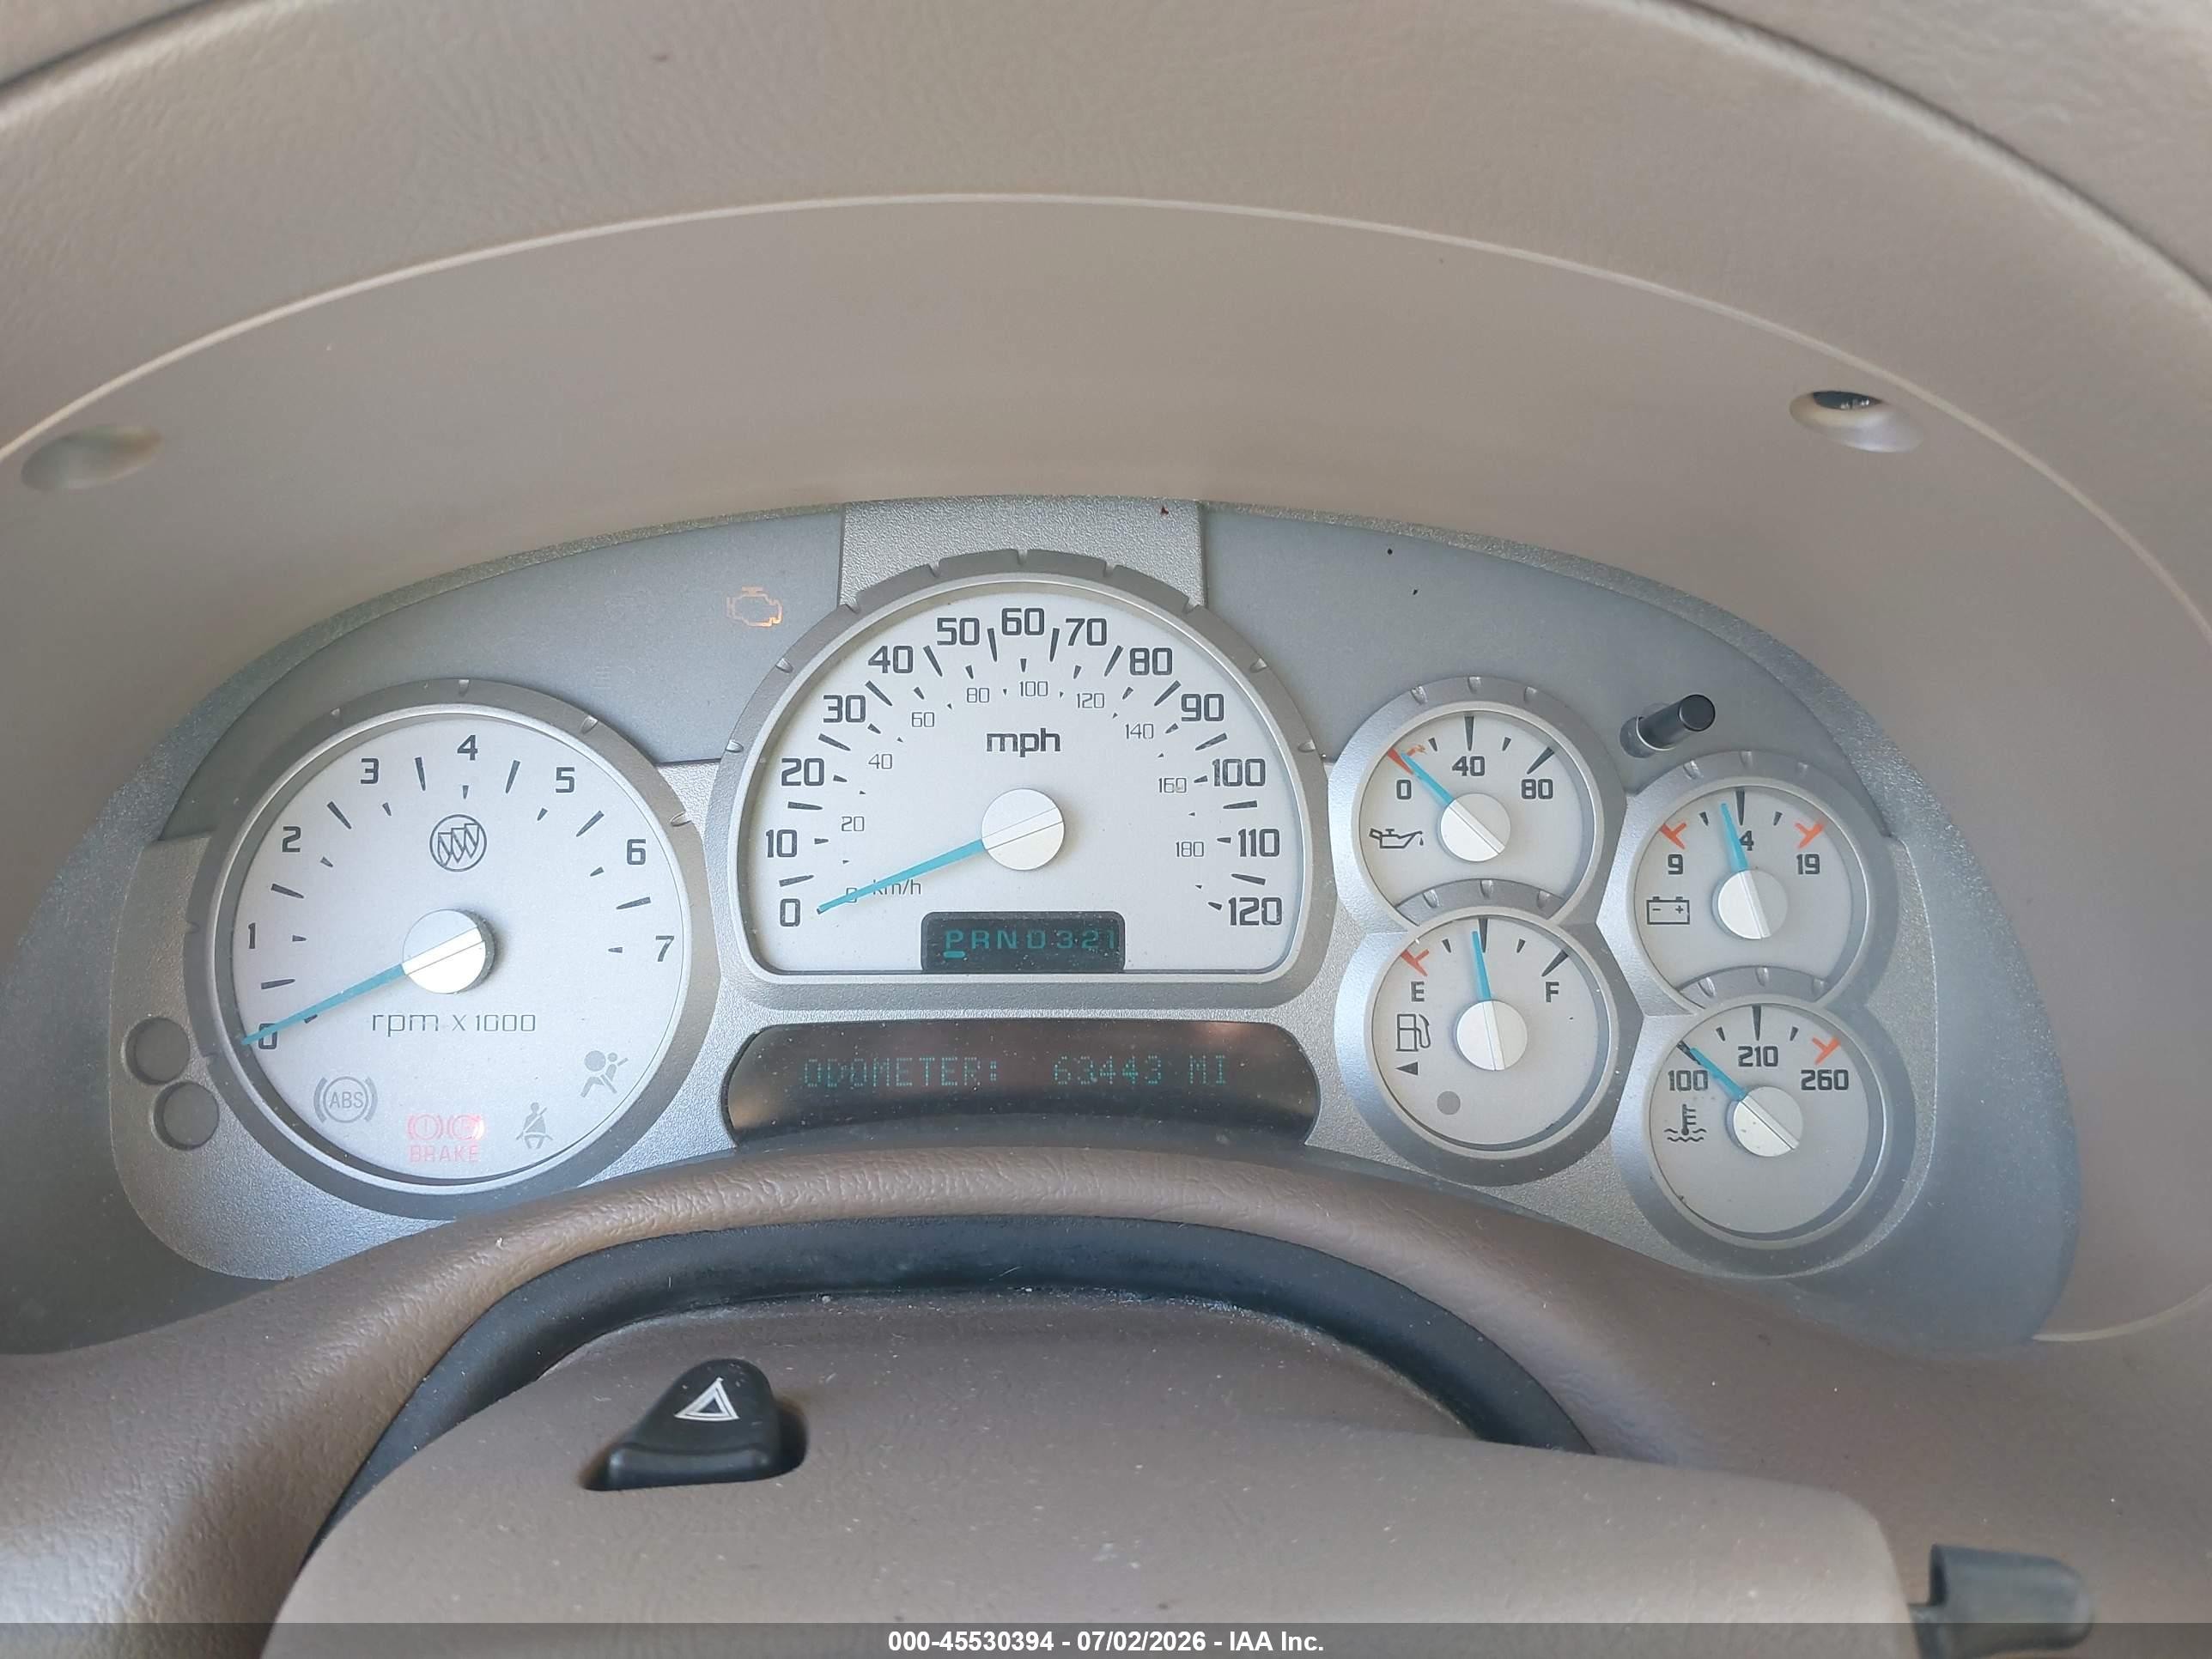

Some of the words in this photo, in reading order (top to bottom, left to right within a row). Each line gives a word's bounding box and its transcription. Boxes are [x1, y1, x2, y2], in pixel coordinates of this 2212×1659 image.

[938, 617, 980, 645] 50
[1002, 608, 1044, 635] 60
[1066, 618, 1107, 646] 70
[868, 646, 913, 673] 40
[1130, 647, 1172, 675] 80
[967, 688, 989, 702] 80
[1020, 681, 1048, 696] 100
[1077, 693, 1104, 708] 120
[823, 695, 866, 722] 30
[912, 712, 934, 727] 60
[1182, 694, 1224, 721] 90
[987, 727, 1060, 757] mph
[1126, 724, 1153, 738] 140
[458, 735, 477, 760] 4
[361, 758, 379, 784] 3
[781, 758, 824, 786] 20
[868, 754, 892, 769] 40
[1212, 759, 1266, 787] 100
[1452, 757, 1485, 776] 40
[556, 767, 574, 793] 5
[1159, 778, 1187, 793] 160
[1396, 780, 1412, 799] 0
[1522, 779, 1553, 799] 80
[842, 817, 864, 831] 20
[283, 826, 301, 852] 2
[766, 830, 797, 858] 10
[1176, 842, 1204, 857] 180
[1238, 829, 1279, 857] 110
[627, 839, 646, 865] 6
[1668, 854, 1683, 874] 9
[1796, 854, 1820, 874] 19
[780, 899, 800, 927] 0
[1229, 897, 1282, 926] 120
[246, 922, 257, 950] 1
[656, 936, 674, 962] 7
[1411, 981, 1425, 1001] E
[1546, 981, 1559, 1002] F
[258, 1023, 277, 1049] 0
[373, 1015, 438, 1037] rpm
[475, 1015, 535, 1031] 1000
[1738, 1046, 1778, 1066] 210
[803, 1056, 998, 1088] ODOMETER:
[1054, 1054, 1162, 1085] 63443
[1188, 1054, 1227, 1085] MI
[1668, 1070, 1708, 1091] 100
[1802, 1070, 1849, 1091] 260
[329, 1091, 364, 1109] ABS
[410, 1146, 480, 1163] BRAKE
